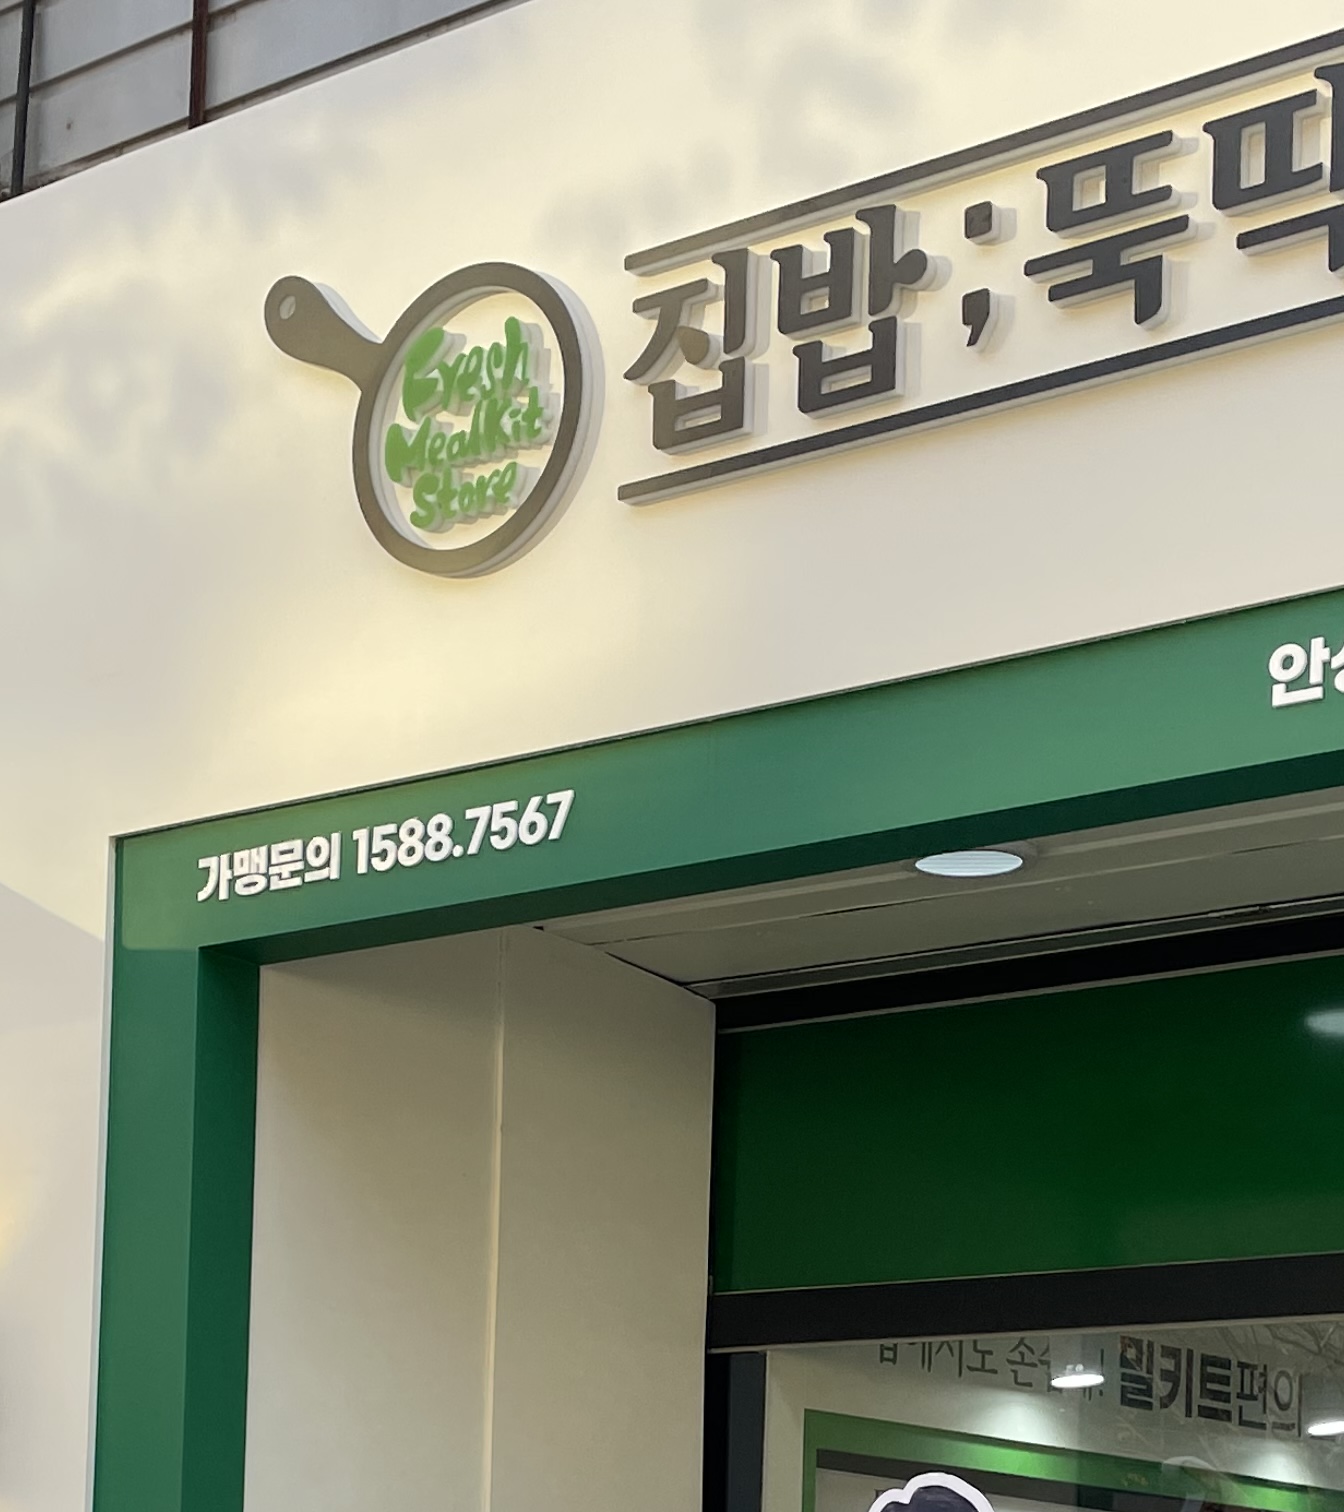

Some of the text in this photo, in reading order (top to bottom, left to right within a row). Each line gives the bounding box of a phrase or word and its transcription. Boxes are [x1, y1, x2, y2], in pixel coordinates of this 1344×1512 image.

[402, 316, 531, 421] Fresh
[409, 462, 518, 530] Store
[196, 789, 576, 902] 가맹문의 1588.7567
